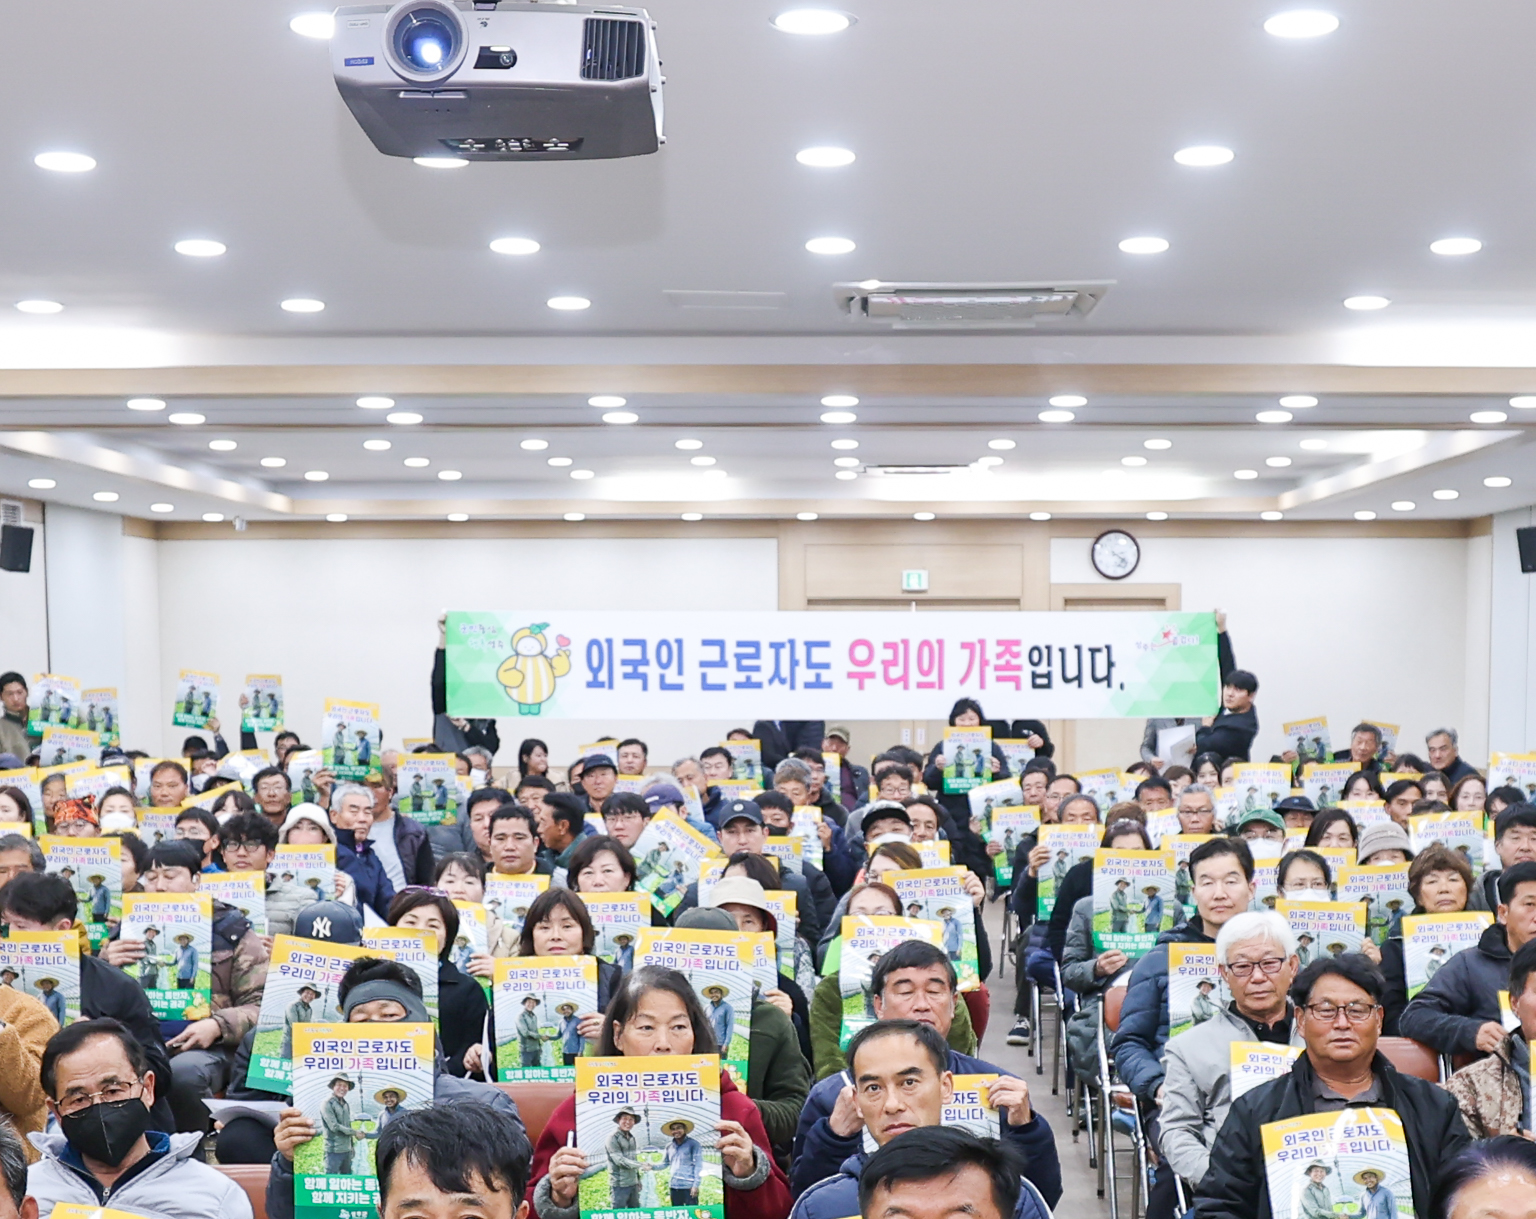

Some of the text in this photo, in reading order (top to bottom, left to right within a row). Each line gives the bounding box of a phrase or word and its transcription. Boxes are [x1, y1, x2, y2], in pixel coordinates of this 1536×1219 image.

[585, 637, 1126, 692] 외국인 근로자도 우리의 가족입니다.
[312, 916, 332, 938] NY
[651, 941, 736, 958] 외국인 근로자도
[289, 951, 328, 970] 외국인
[681, 957, 743, 972] 가족입니다.
[1185, 956, 1214, 965] 외국인
[278, 963, 316, 981] 우리의
[509, 968, 582, 980] 외국인 근로자도
[1178, 967, 1208, 976] 우리의
[502, 982, 532, 992] 우리의
[312, 1040, 412, 1054] 외국인 근로자도
[303, 1057, 421, 1070] 우리의 가족입니다.
[596, 1072, 698, 1088] 외국인 근로자도
[587, 1089, 708, 1105] 우리의 가족입니다.
